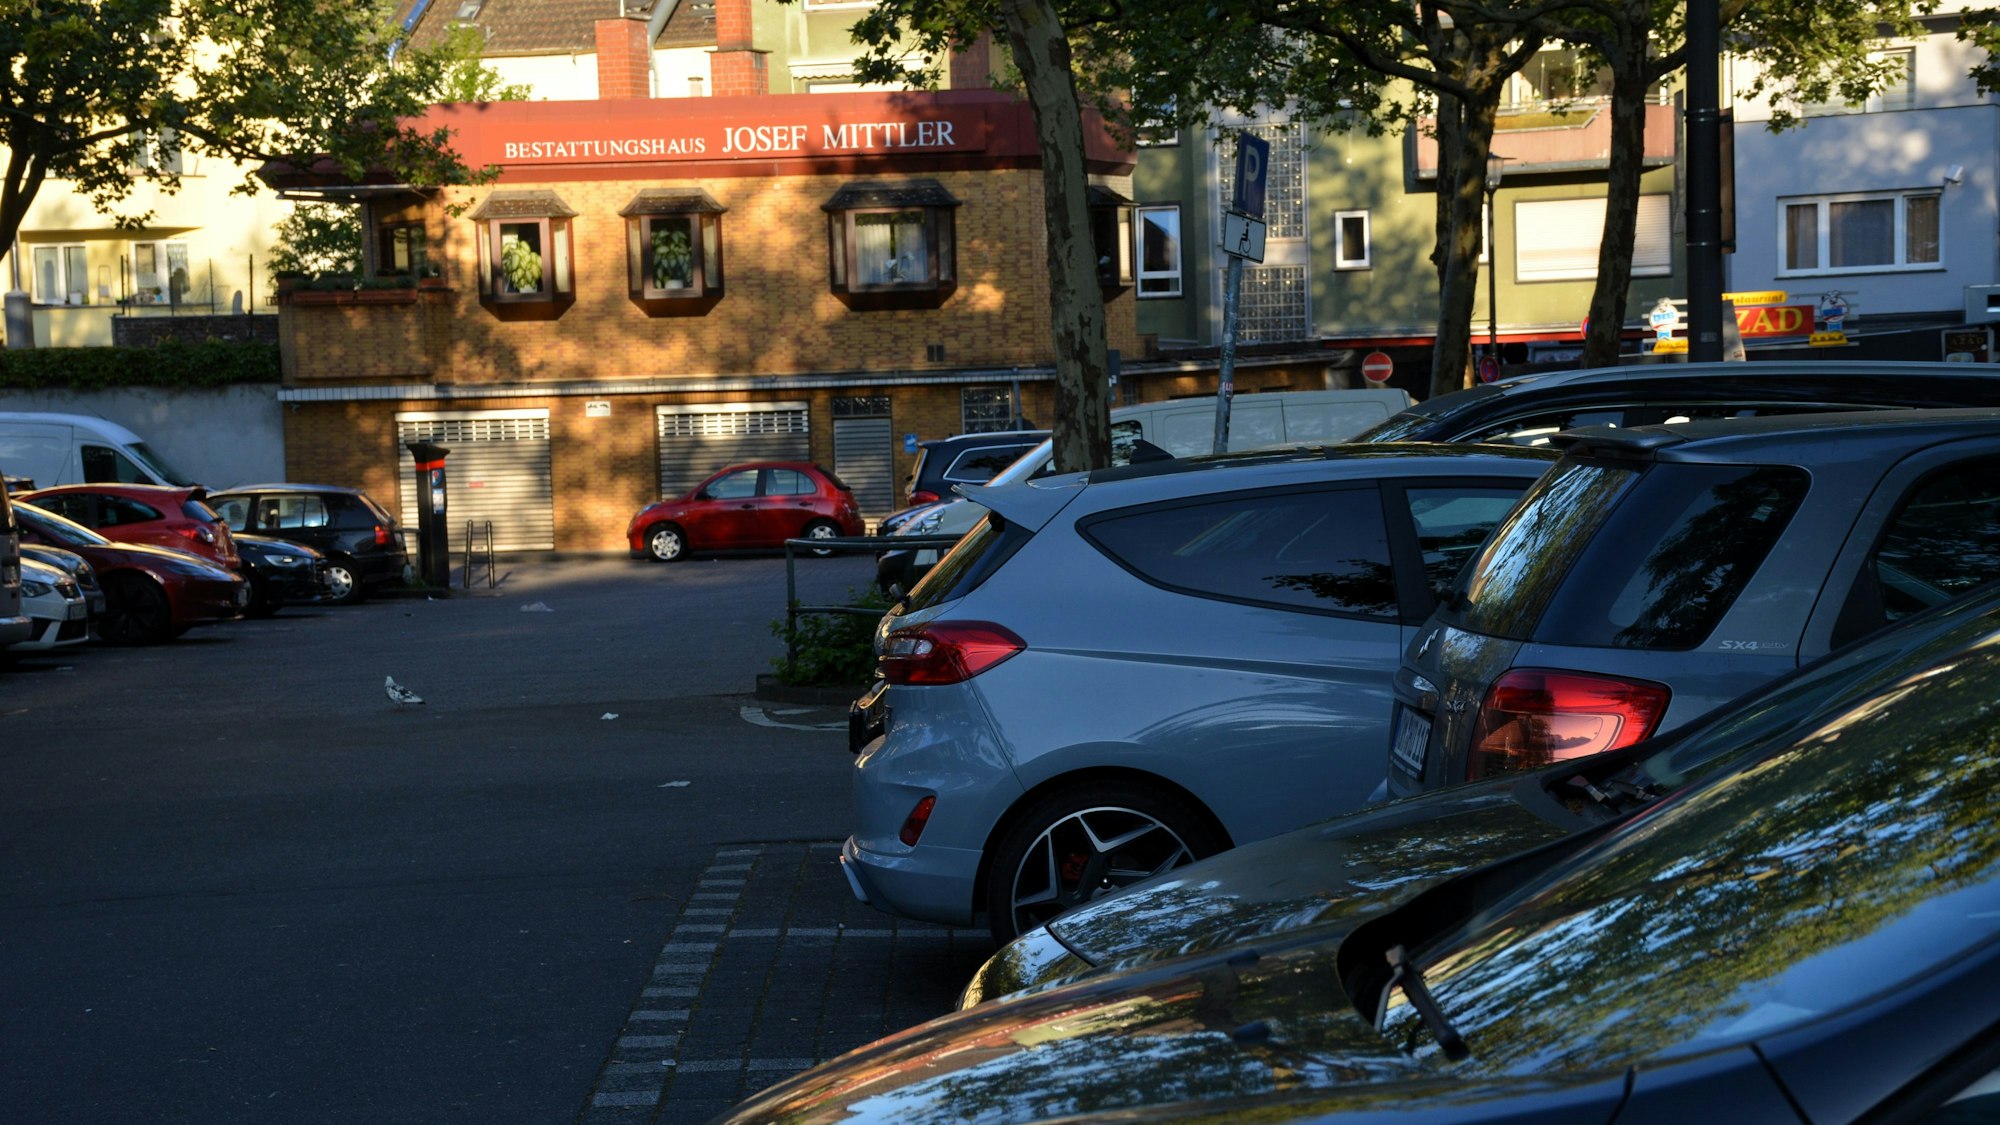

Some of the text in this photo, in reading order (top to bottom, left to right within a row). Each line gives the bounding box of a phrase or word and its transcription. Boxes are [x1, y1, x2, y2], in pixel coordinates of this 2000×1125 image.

[505, 121, 955, 159] BESTATTUNGSHAUS JOSEF MITTLER
[1242, 144, 1261, 201] P
[1718, 640, 1759, 650] SX4
